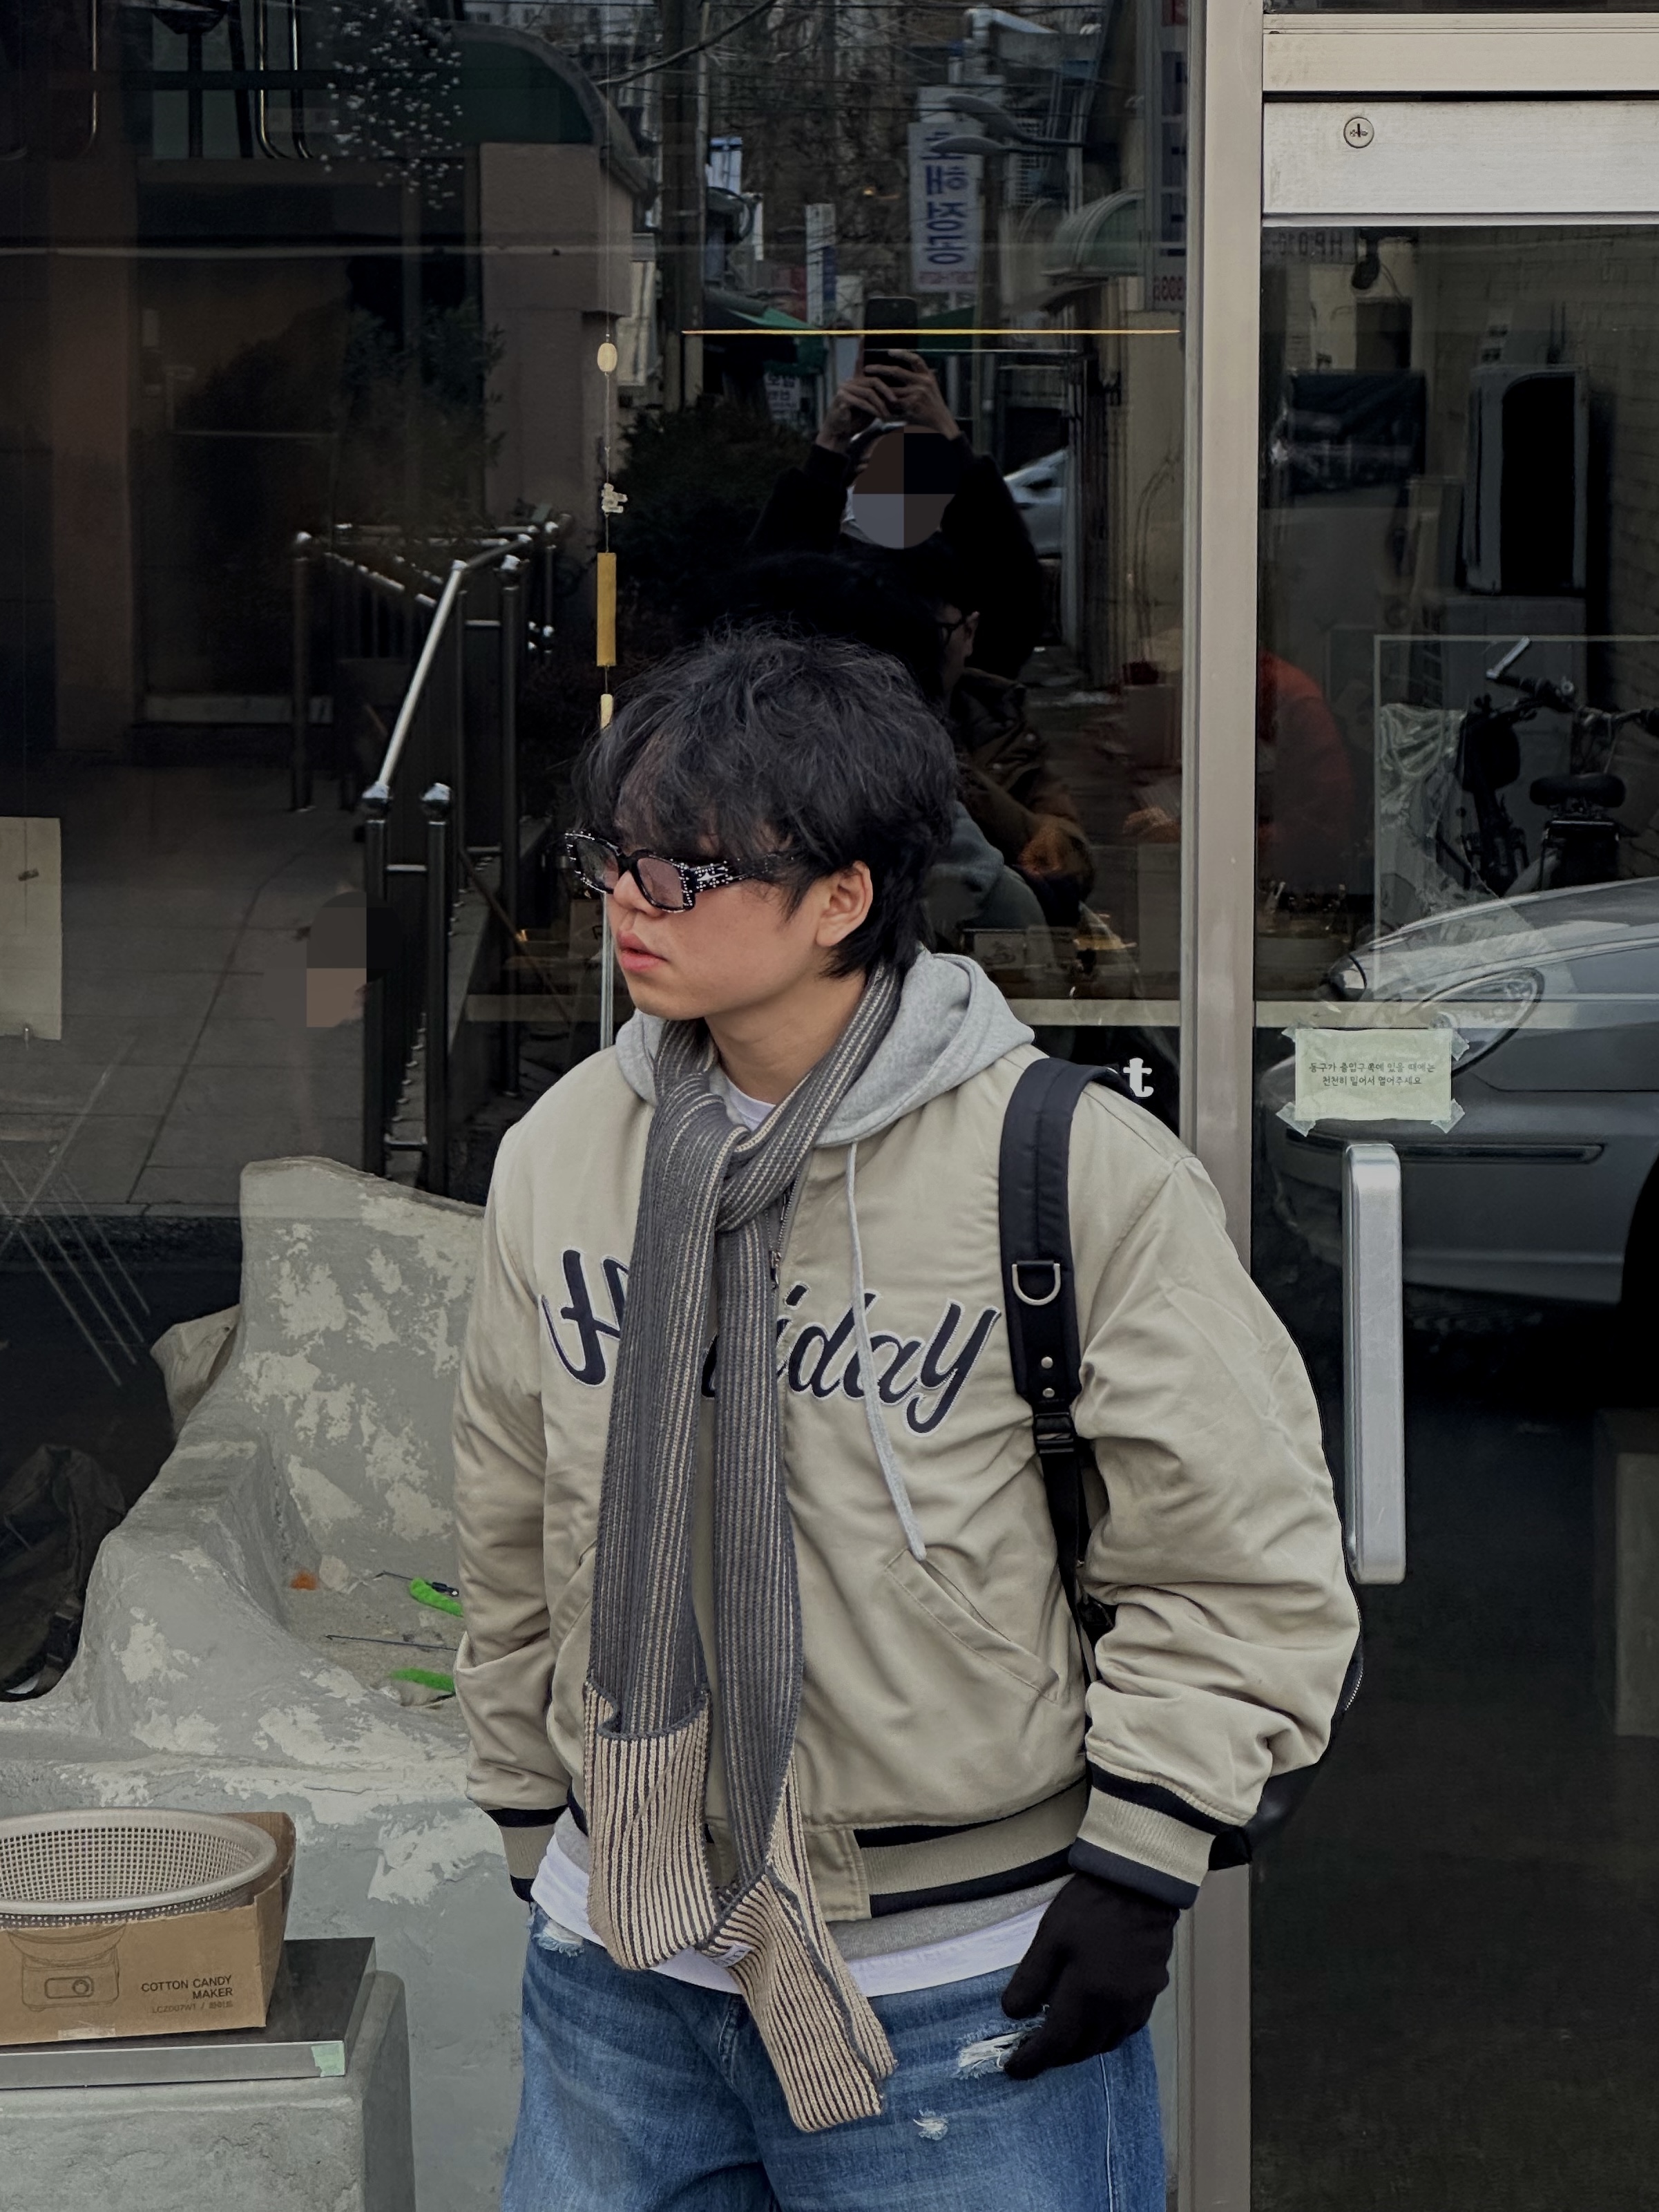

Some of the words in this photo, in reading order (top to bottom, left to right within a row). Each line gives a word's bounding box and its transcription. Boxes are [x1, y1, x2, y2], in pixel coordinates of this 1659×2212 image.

[1388, 1062, 1405, 1073] 있을
[1408, 1062, 1436, 1073] 때에는
[1108, 1057, 1155, 1098] t
[1323, 1076, 1347, 1086] 천천히
[539, 1247, 1001, 1436] Hiday
[141, 1979, 189, 1992] COTTON
[193, 1974, 231, 1988] CANDY
[193, 1987, 233, 1999] MAKER
